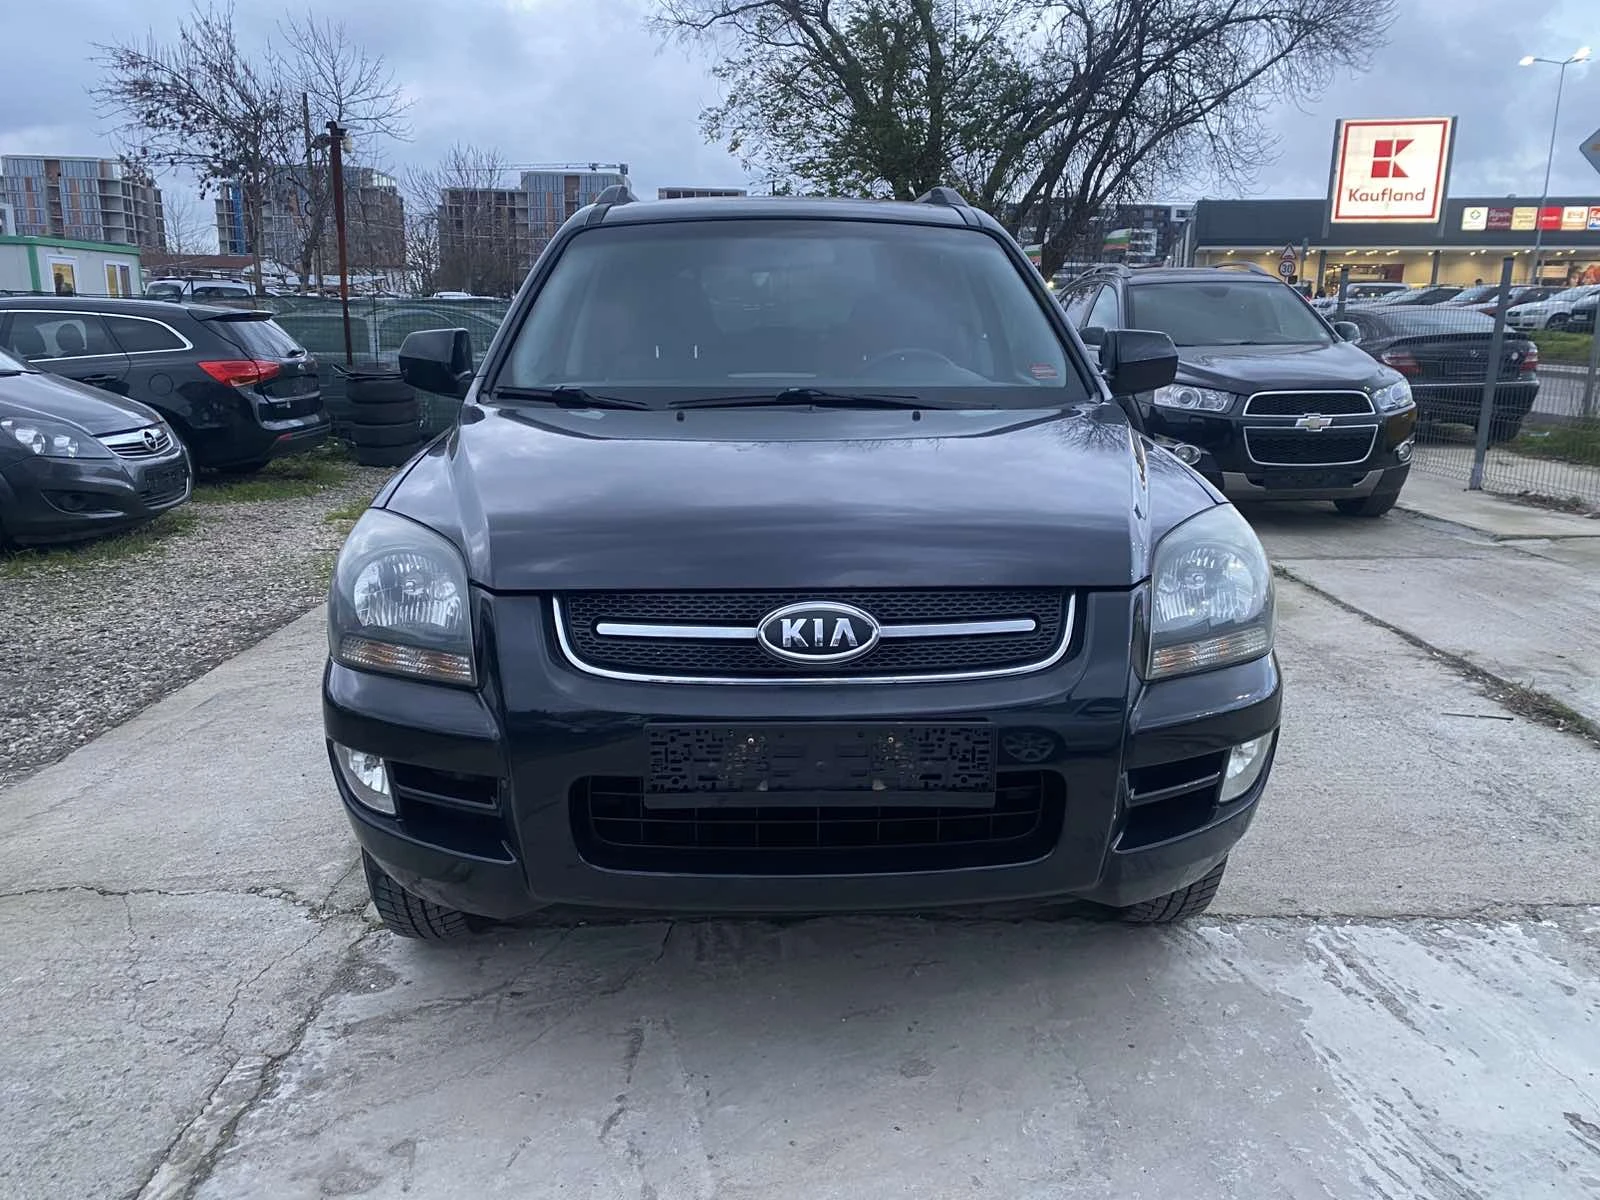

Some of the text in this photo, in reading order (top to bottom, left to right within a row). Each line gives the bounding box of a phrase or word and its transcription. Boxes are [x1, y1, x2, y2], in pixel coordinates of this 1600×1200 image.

[1348, 187, 1426, 202] Kaufland
[1281, 264, 1293, 273] 30
[780, 618, 859, 648] KIA
